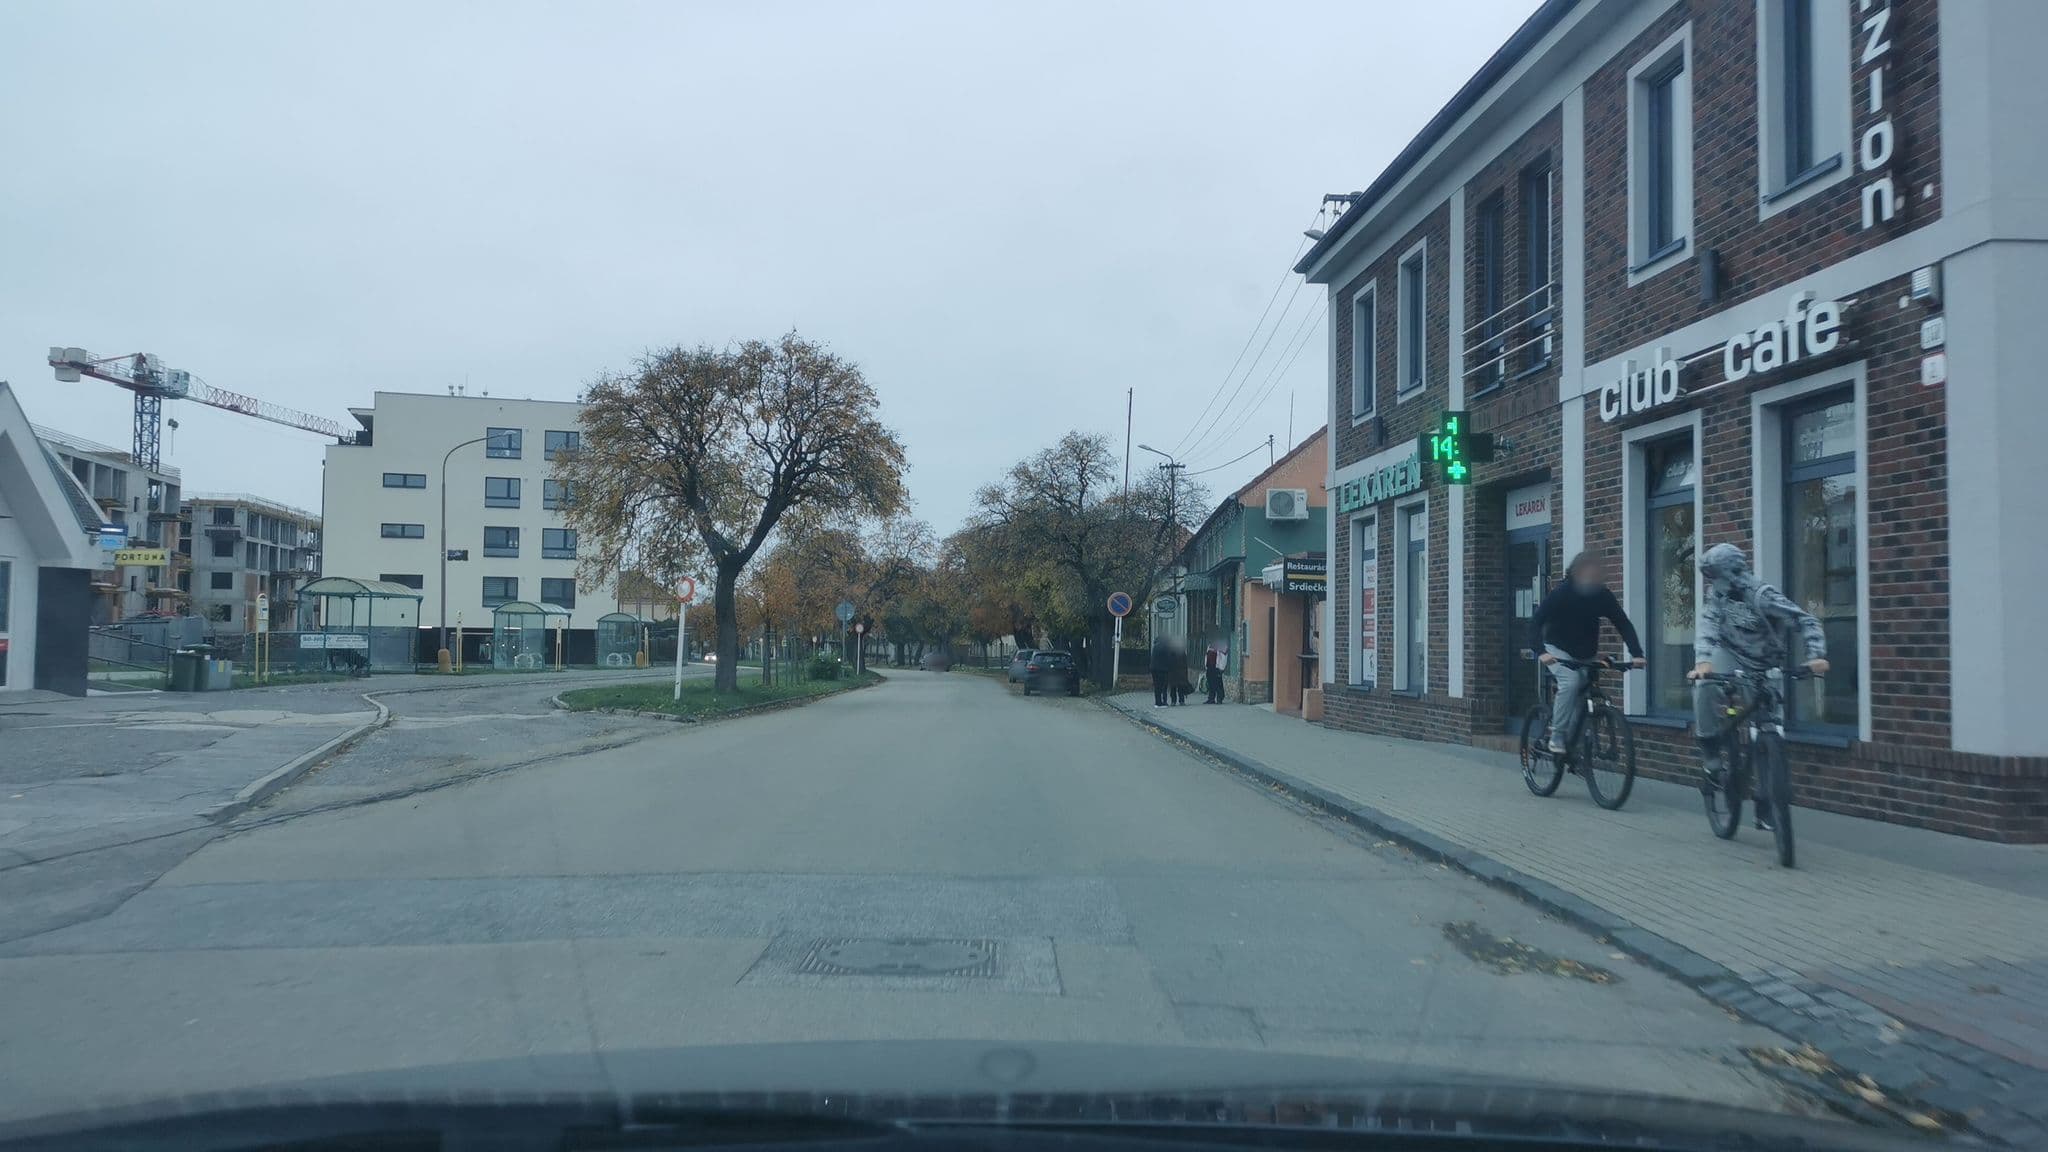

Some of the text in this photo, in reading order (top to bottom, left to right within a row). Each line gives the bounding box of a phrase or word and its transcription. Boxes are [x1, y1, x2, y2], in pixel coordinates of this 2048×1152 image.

[1861, 0, 1894, 229] zion
[1600, 290, 1841, 422] club cafe
[1340, 451, 1421, 513] LEKÁREŇ
[115, 553, 166, 561] FORTUNA
